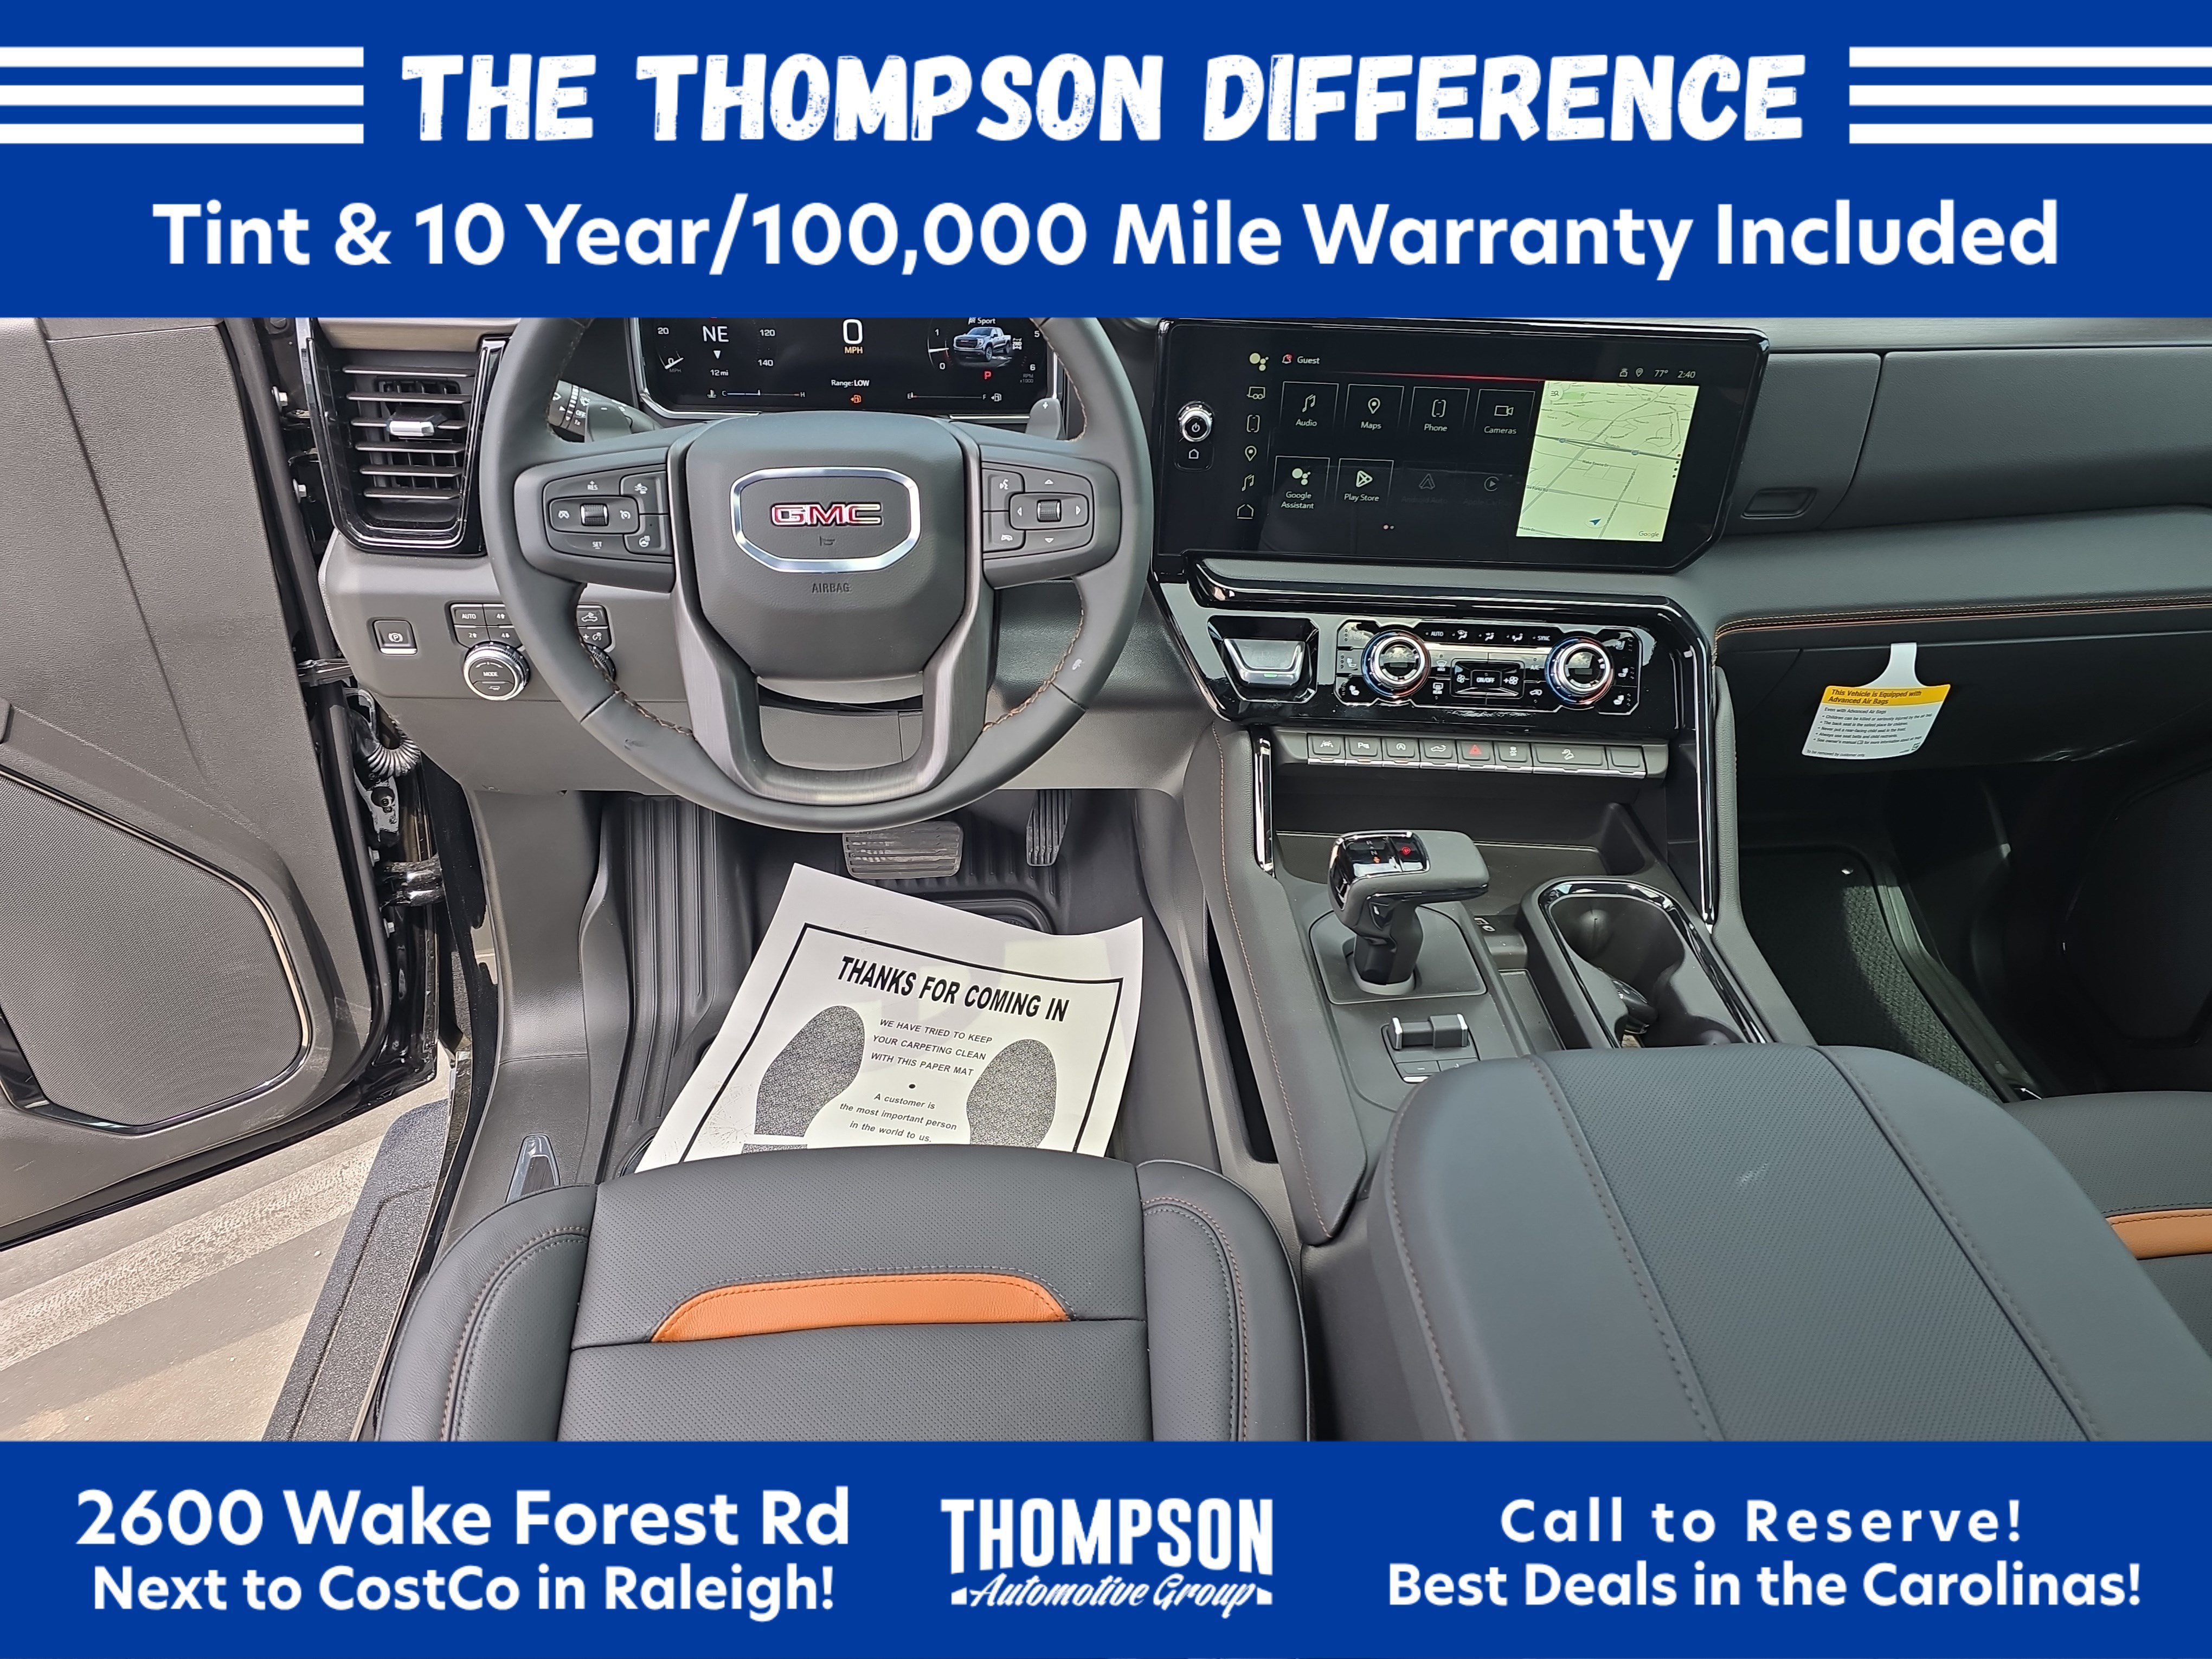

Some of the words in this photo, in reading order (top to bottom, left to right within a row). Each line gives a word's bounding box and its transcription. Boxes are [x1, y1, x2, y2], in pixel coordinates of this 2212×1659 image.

[978, 317, 996, 325] Sport
[703, 325, 729, 343] NE
[760, 329, 776, 337] 120
[843, 318, 863, 345] 0
[757, 359, 774, 367] 140
[1297, 356, 1321, 364] Guest
[939, 362, 946, 370] 0
[984, 371, 992, 380] P
[1654, 369, 1669, 378] 77°
[1677, 370, 1696, 379] 2:40
[831, 379, 854, 388] Range:
[575, 409, 586, 417] OFF
[1295, 419, 1318, 427] Audio
[1360, 421, 1382, 430] Maps
[1424, 423, 1448, 432] Phone
[1484, 426, 1517, 434] Cameras
[1285, 491, 1312, 500] Google
[1344, 493, 1359, 503] Play
[1359, 493, 1380, 502] Store
[1281, 501, 1314, 510] Assistant
[771, 503, 884, 527] GMC
[1638, 530, 1660, 538] Google
[812, 582, 850, 593] AIRBAG
[837, 956, 917, 996] THANKS
[918, 976, 961, 1005] FOR
[964, 985, 1041, 1018] COMING
[1045, 998, 1070, 1023] IN
[879, 1019, 895, 1027] WE
[896, 1022, 922, 1032] HAVE
[924, 1026, 950, 1037] TRIED
[954, 1031, 966, 1039] TO
[968, 1033, 993, 1044] KEEP
[873, 1034, 898, 1046] YOUR
[901, 1040, 953, 1054] CARPETING
[955, 1049, 987, 1060] CLEAN
[871, 1052, 895, 1063] WITH
[897, 1057, 917, 1067] THIS
[919, 1061, 951, 1072] PAPER
[953, 1066, 974, 1077] MAT
[884, 1096, 925, 1108] customer
[927, 1101, 936, 1109] is
[840, 1103, 854, 1111] the
[856, 1107, 879, 1116] most
[880, 1110, 924, 1124] important
[925, 1118, 957, 1130] person
[849, 1120, 859, 1129] in
[861, 1123, 876, 1132] the
[879, 1127, 904, 1136] world
[906, 1130, 916, 1139] to
[918, 1134, 932, 1143] us.
